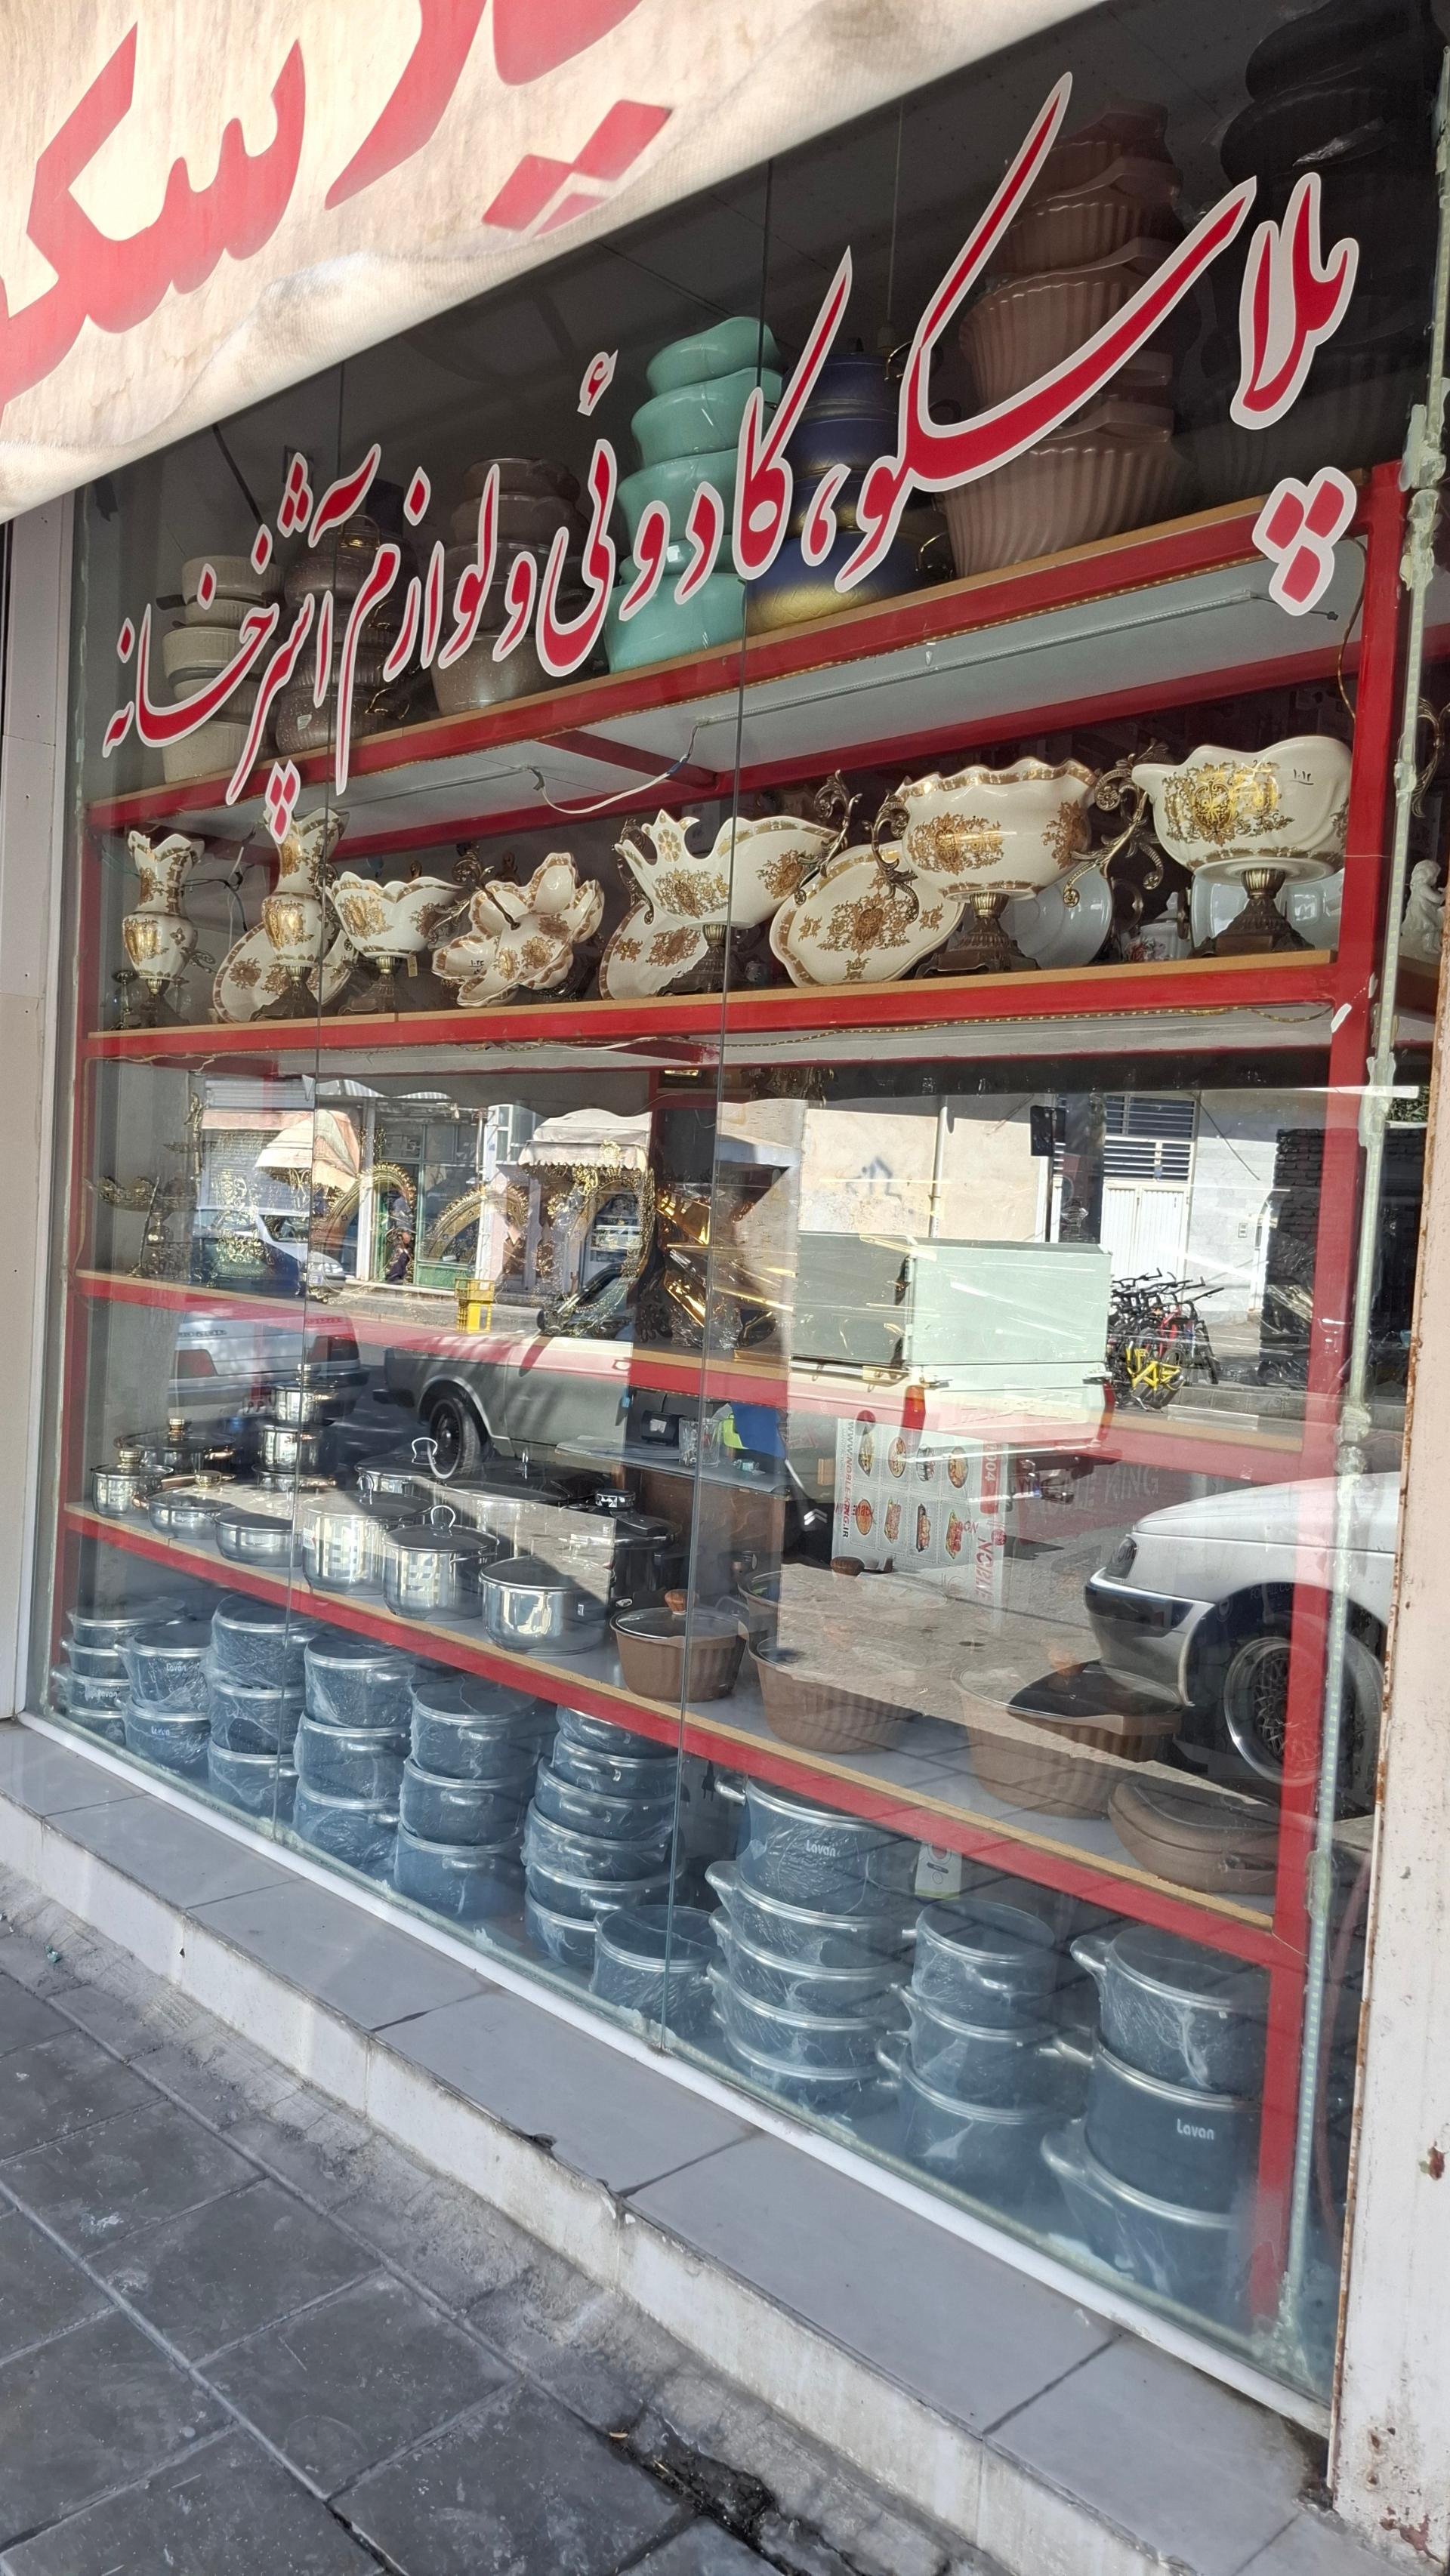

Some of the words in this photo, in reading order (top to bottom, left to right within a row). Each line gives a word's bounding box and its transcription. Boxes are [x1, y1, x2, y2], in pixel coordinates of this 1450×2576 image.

[335, 464, 500, 796] لوازم
[492, 551, 538, 663] و
[806, 1840, 836, 1857] Lavan
[1177, 2118, 1214, 2140] Lavan
